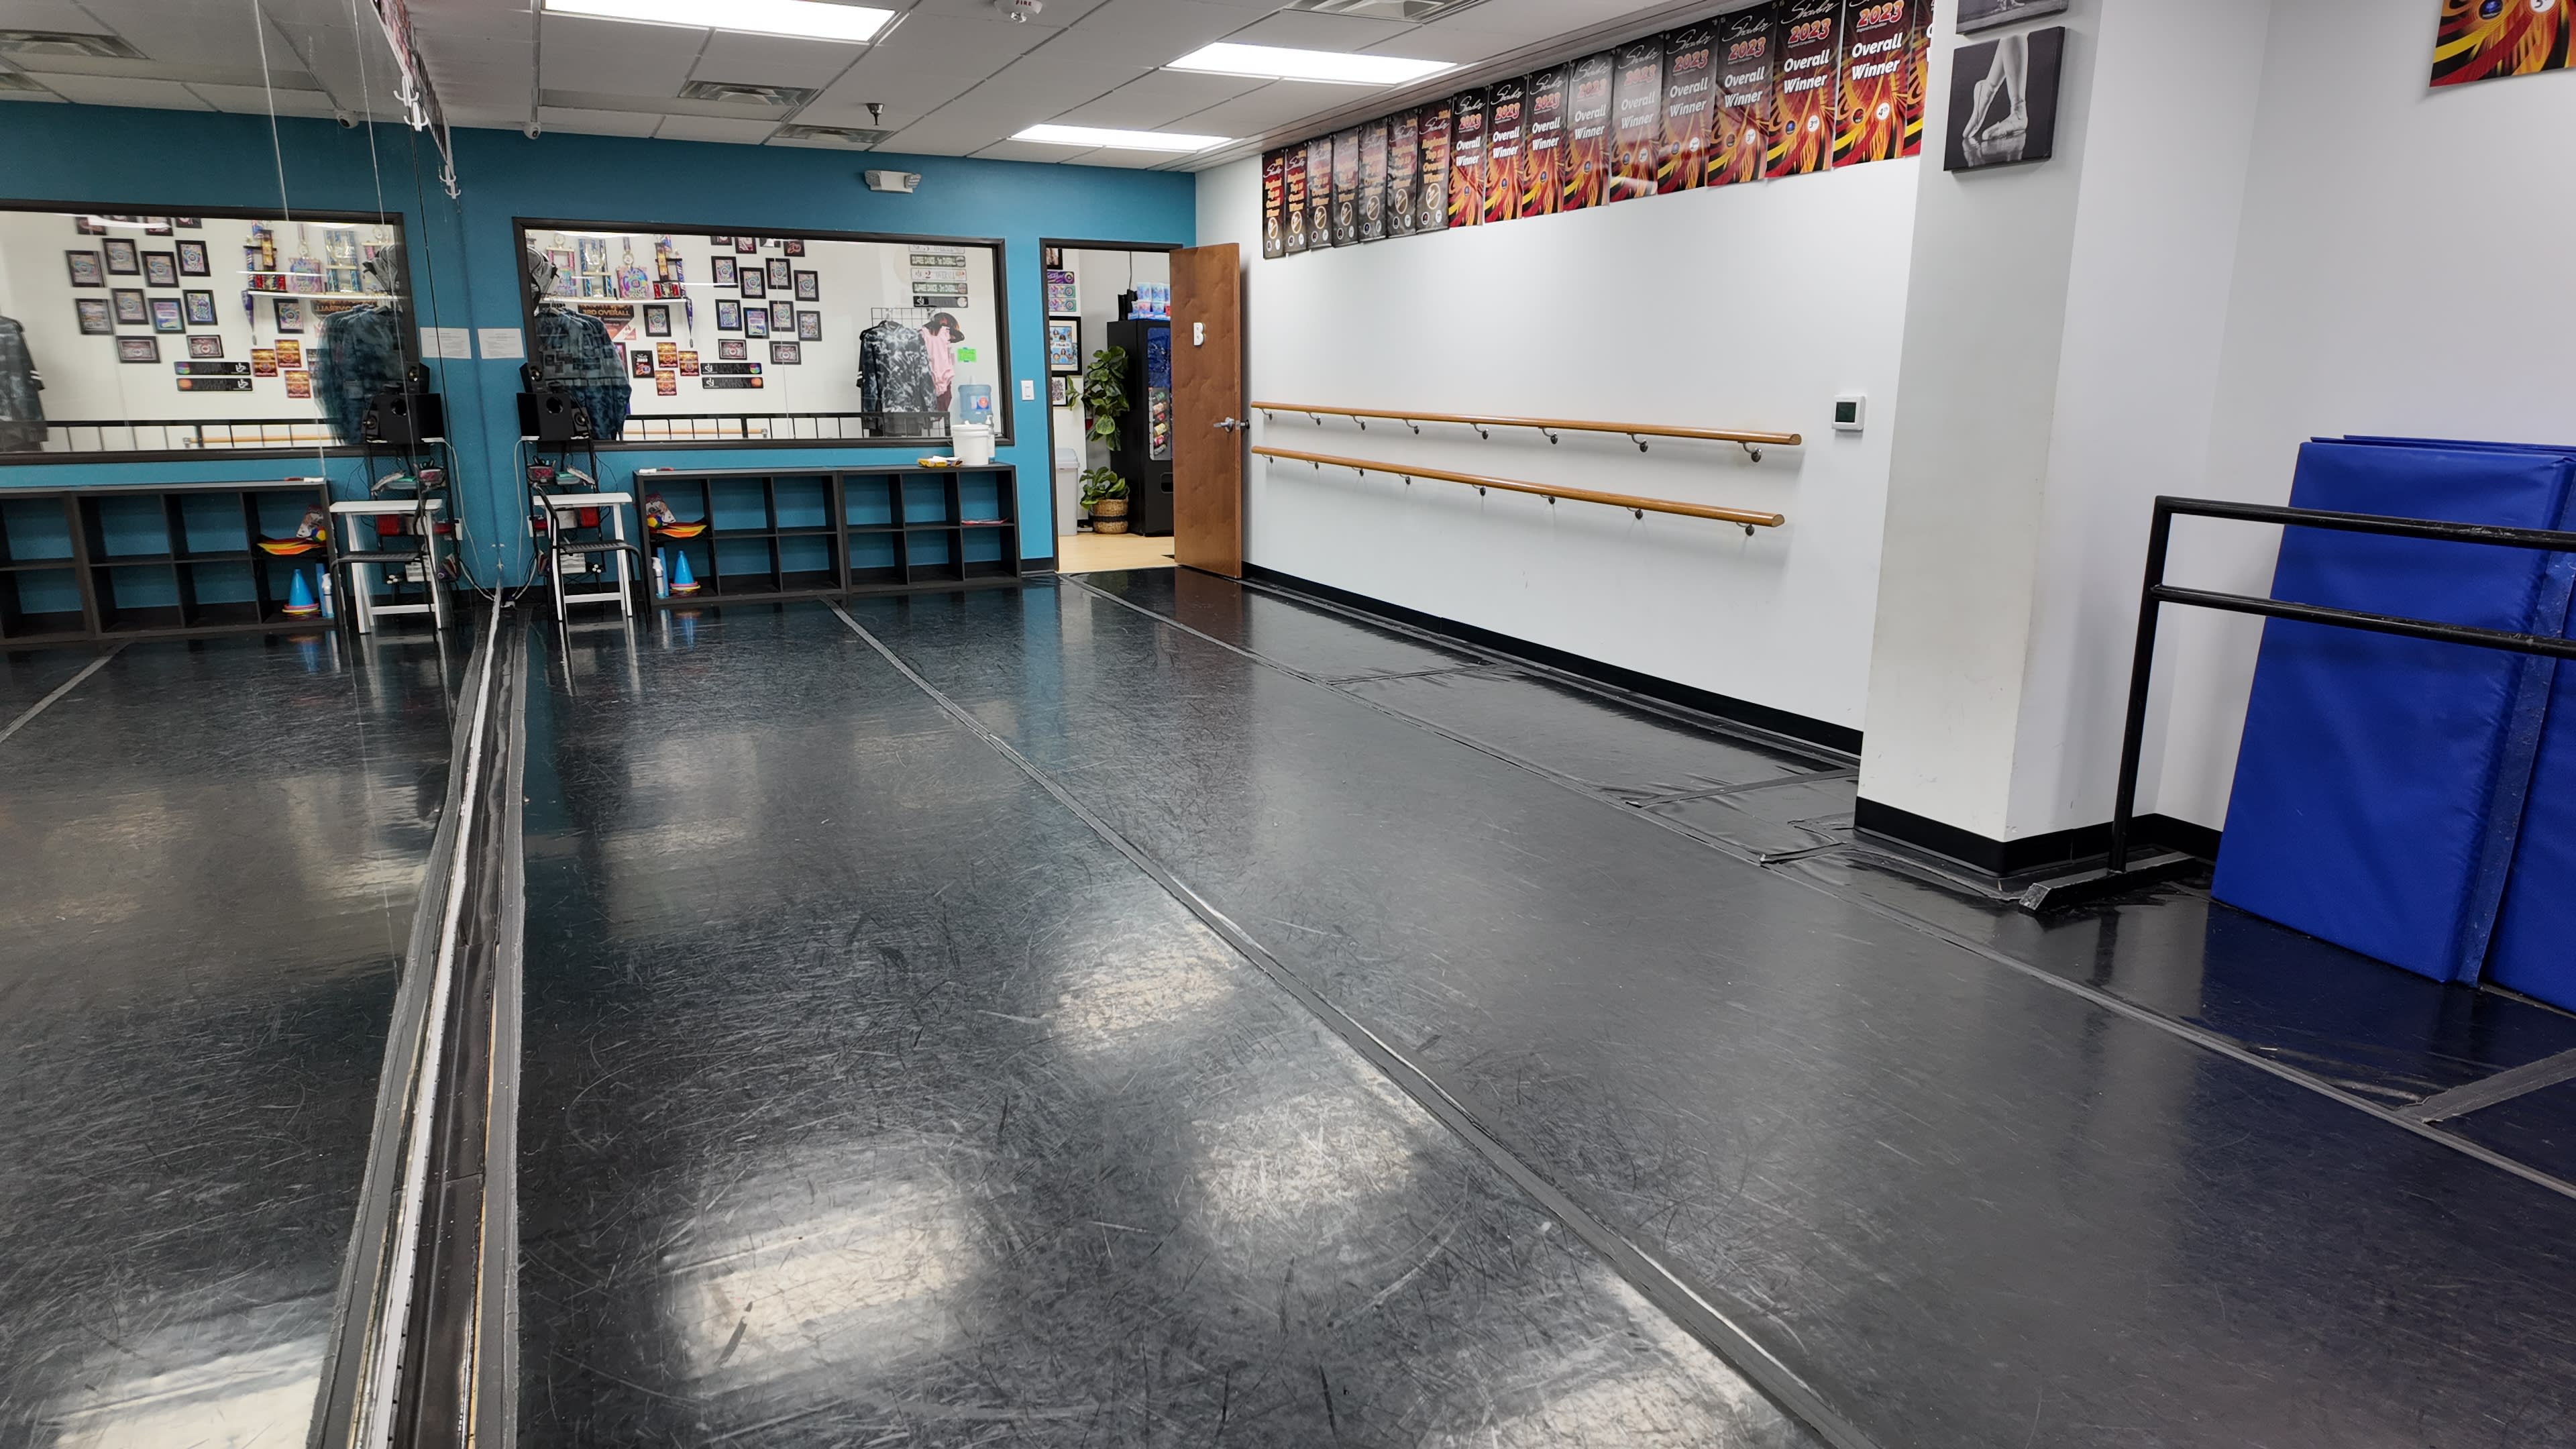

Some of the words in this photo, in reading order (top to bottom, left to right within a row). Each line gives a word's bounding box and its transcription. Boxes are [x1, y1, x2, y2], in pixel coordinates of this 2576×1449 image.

[1857, 0, 1904, 28] 2023
[1788, 17, 1831, 44] 2023
[1728, 36, 1766, 61] 2023
[1851, 32, 1902, 58] Overall
[1673, 48, 1709, 72] 2023
[1784, 49, 1830, 72] Overall
[1624, 64, 1656, 86] 2023
[1725, 66, 1765, 89] Overall
[1851, 60, 1900, 80] Winner
[1577, 78, 1607, 98] 2023
[1670, 77, 1708, 98] Overall
[1784, 74, 1828, 94] Winner
[1534, 92, 1561, 111] 2023
[1621, 91, 1655, 111] Overall
[1670, 99, 1707, 118] Winner
[1724, 90, 1763, 108] Winner
[1495, 102, 1520, 121] 2023
[1574, 107, 1606, 122] Overall
[1621, 113, 1654, 129] Winner
[1878, 106, 1889, 117] 4th
[1459, 113, 1482, 130] 2023
[1532, 117, 1560, 134] Overall
[1809, 119, 1819, 128] 3rd
[1493, 127, 1519, 142] Overall
[1574, 125, 1605, 140] Winner
[1456, 136, 1481, 151] Overall
[1493, 146, 1518, 159] Winner
[1532, 137, 1559, 151] Winner
[1456, 155, 1479, 166] Winner
[925, 270, 931, 278] 2
[1193, 322, 1205, 346] B
